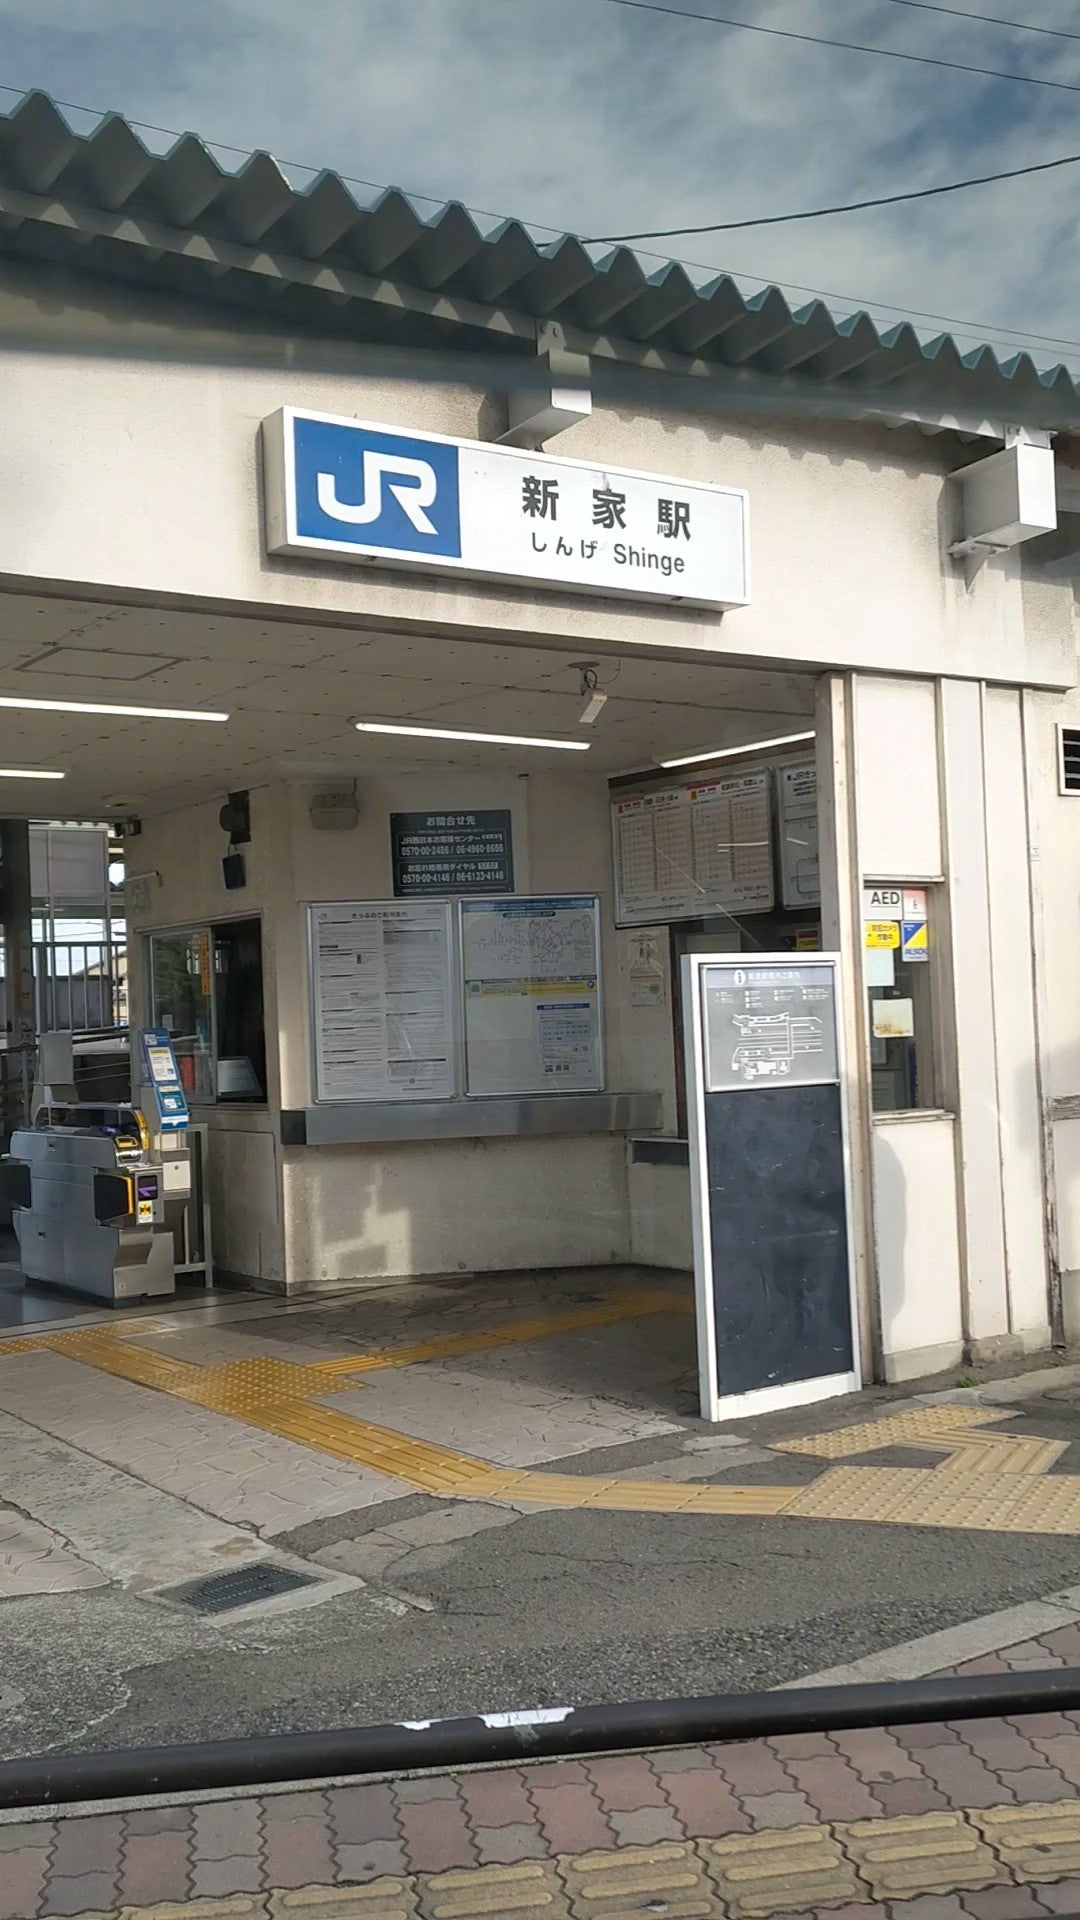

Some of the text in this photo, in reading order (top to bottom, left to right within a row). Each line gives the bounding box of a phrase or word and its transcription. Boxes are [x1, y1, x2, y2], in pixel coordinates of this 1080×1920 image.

[317, 451, 439, 535] JR
[521, 474, 692, 541] 新家駅
[531, 531, 686, 577] しんげ Shinge
[426, 816, 477, 826] お問合せ先
[871, 891, 900, 905] AED
